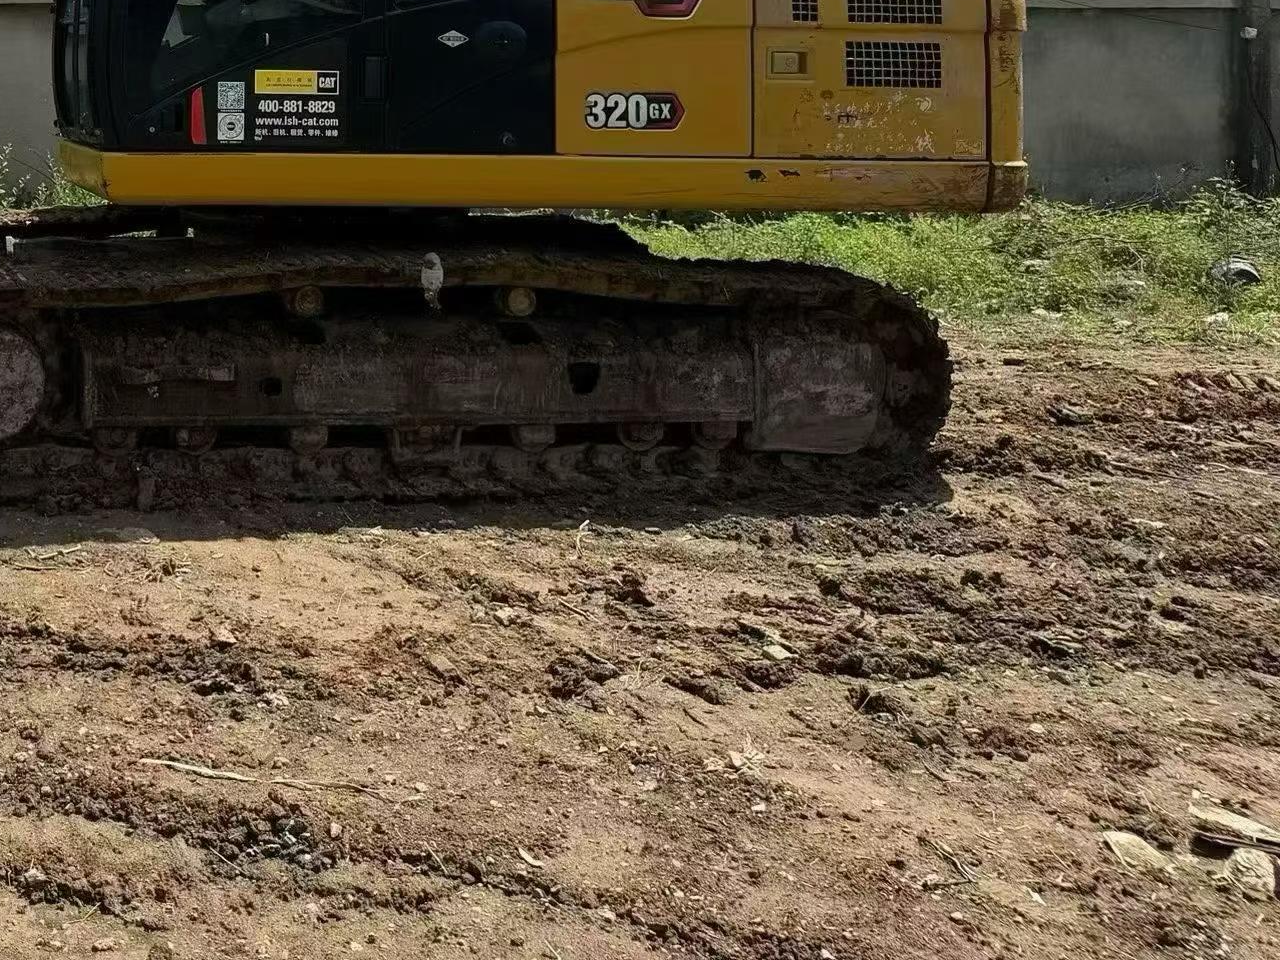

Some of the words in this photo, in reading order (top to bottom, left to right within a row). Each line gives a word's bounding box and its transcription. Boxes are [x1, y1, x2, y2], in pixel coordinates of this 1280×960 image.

[318, 76, 337, 89] CAT
[258, 100, 336, 114] 400-881-8829
[255, 115, 339, 127] www.lsh-cat.com
